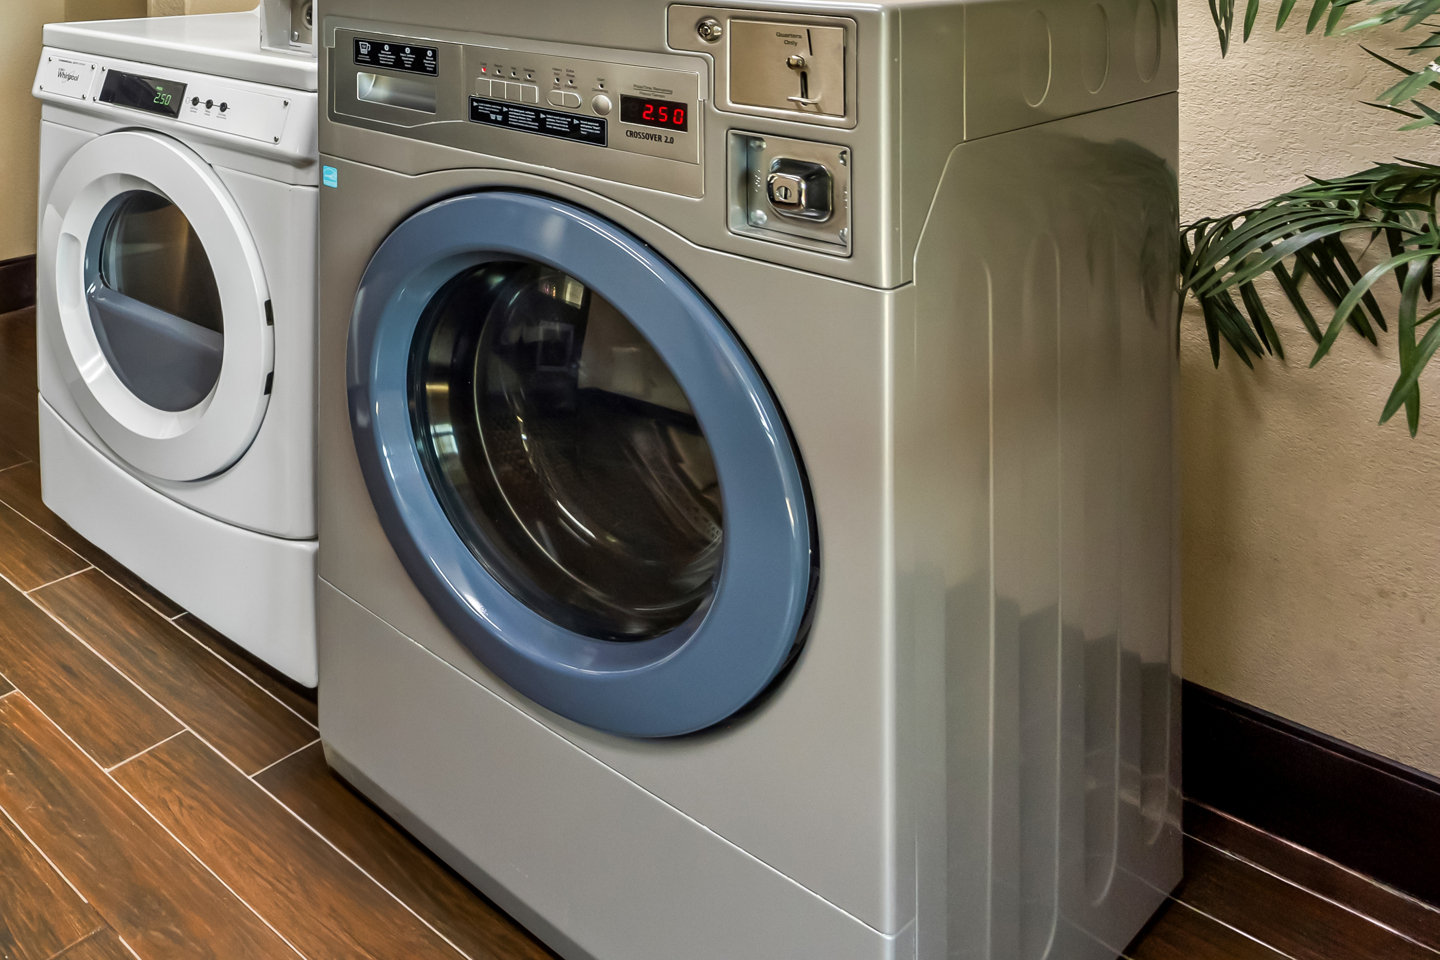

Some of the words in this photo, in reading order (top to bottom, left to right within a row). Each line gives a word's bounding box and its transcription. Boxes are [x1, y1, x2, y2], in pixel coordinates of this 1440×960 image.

[775, 31, 803, 39] Quarters
[783, 39, 799, 47] Only
[57, 70, 80, 82] Whirlpool
[153, 92, 172, 106] 250
[642, 104, 684, 125] 2.50
[625, 129, 663, 143] CROSSOVER
[664, 135, 675, 145] 2.0
